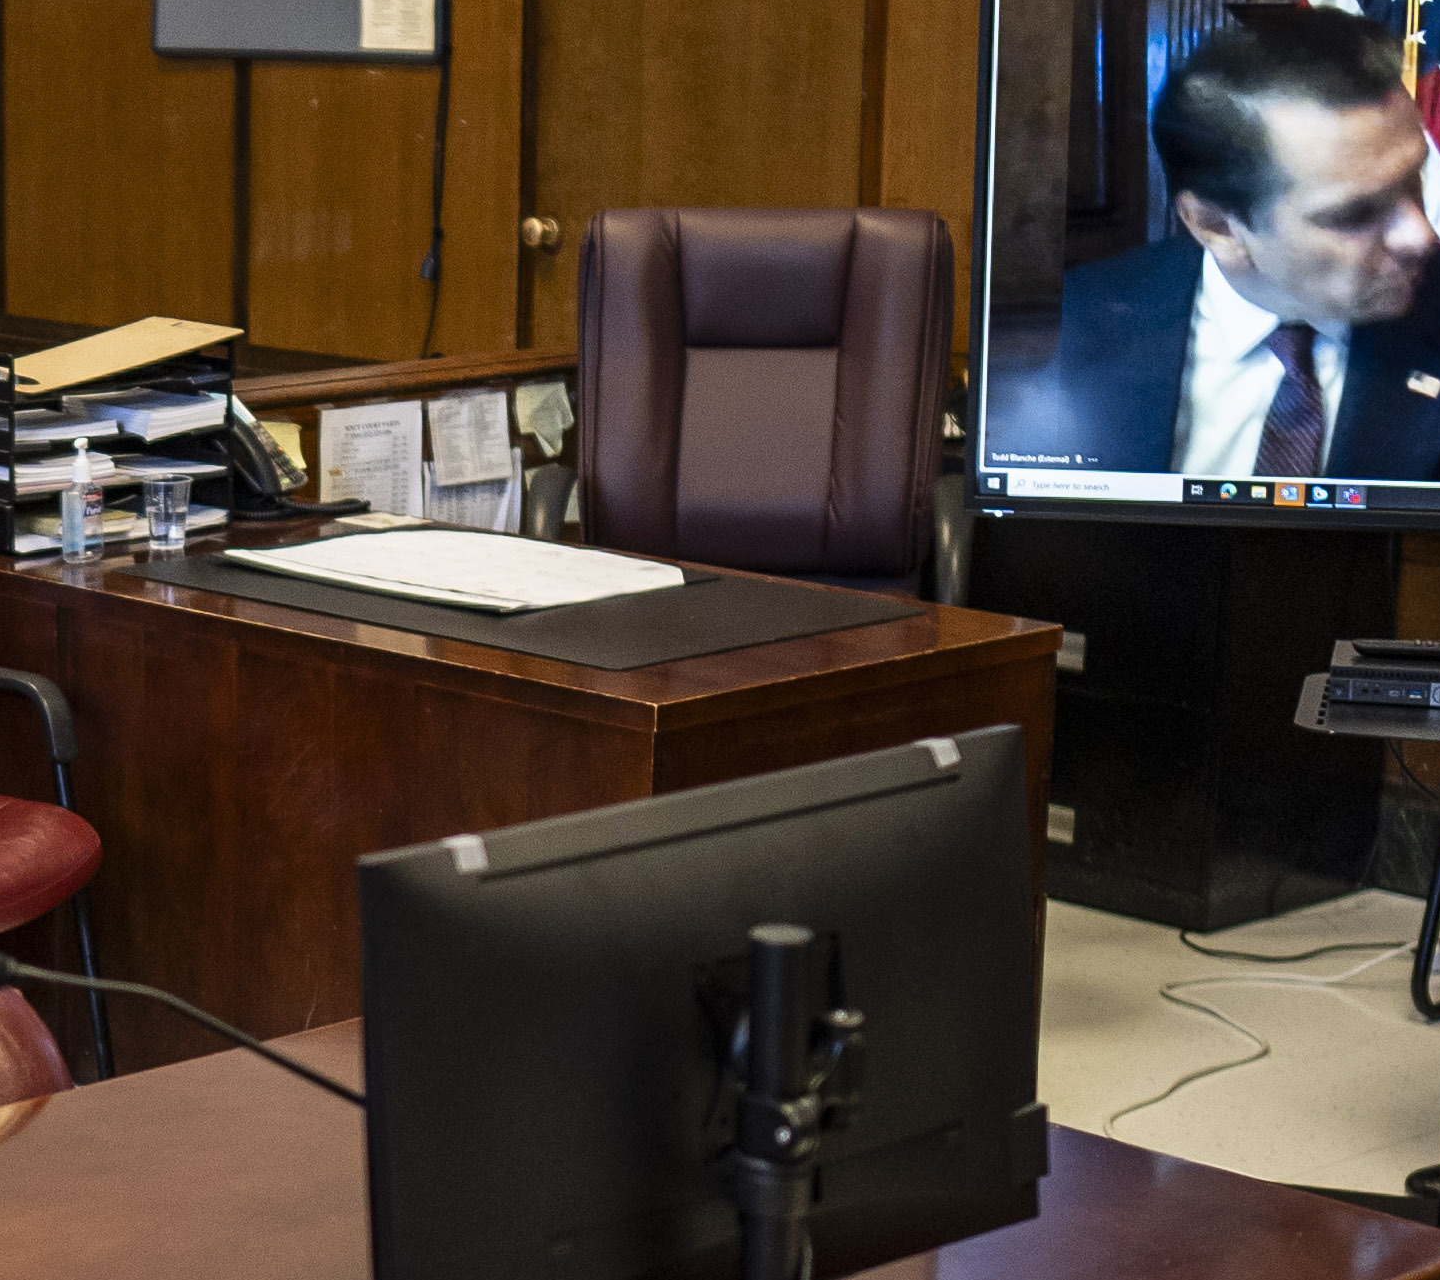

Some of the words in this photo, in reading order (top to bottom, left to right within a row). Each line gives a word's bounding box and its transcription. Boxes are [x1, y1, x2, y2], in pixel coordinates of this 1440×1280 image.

[1032, 481, 1051, 491] Type
[1053, 482, 1071, 490] here
[1083, 483, 1110, 491] search
